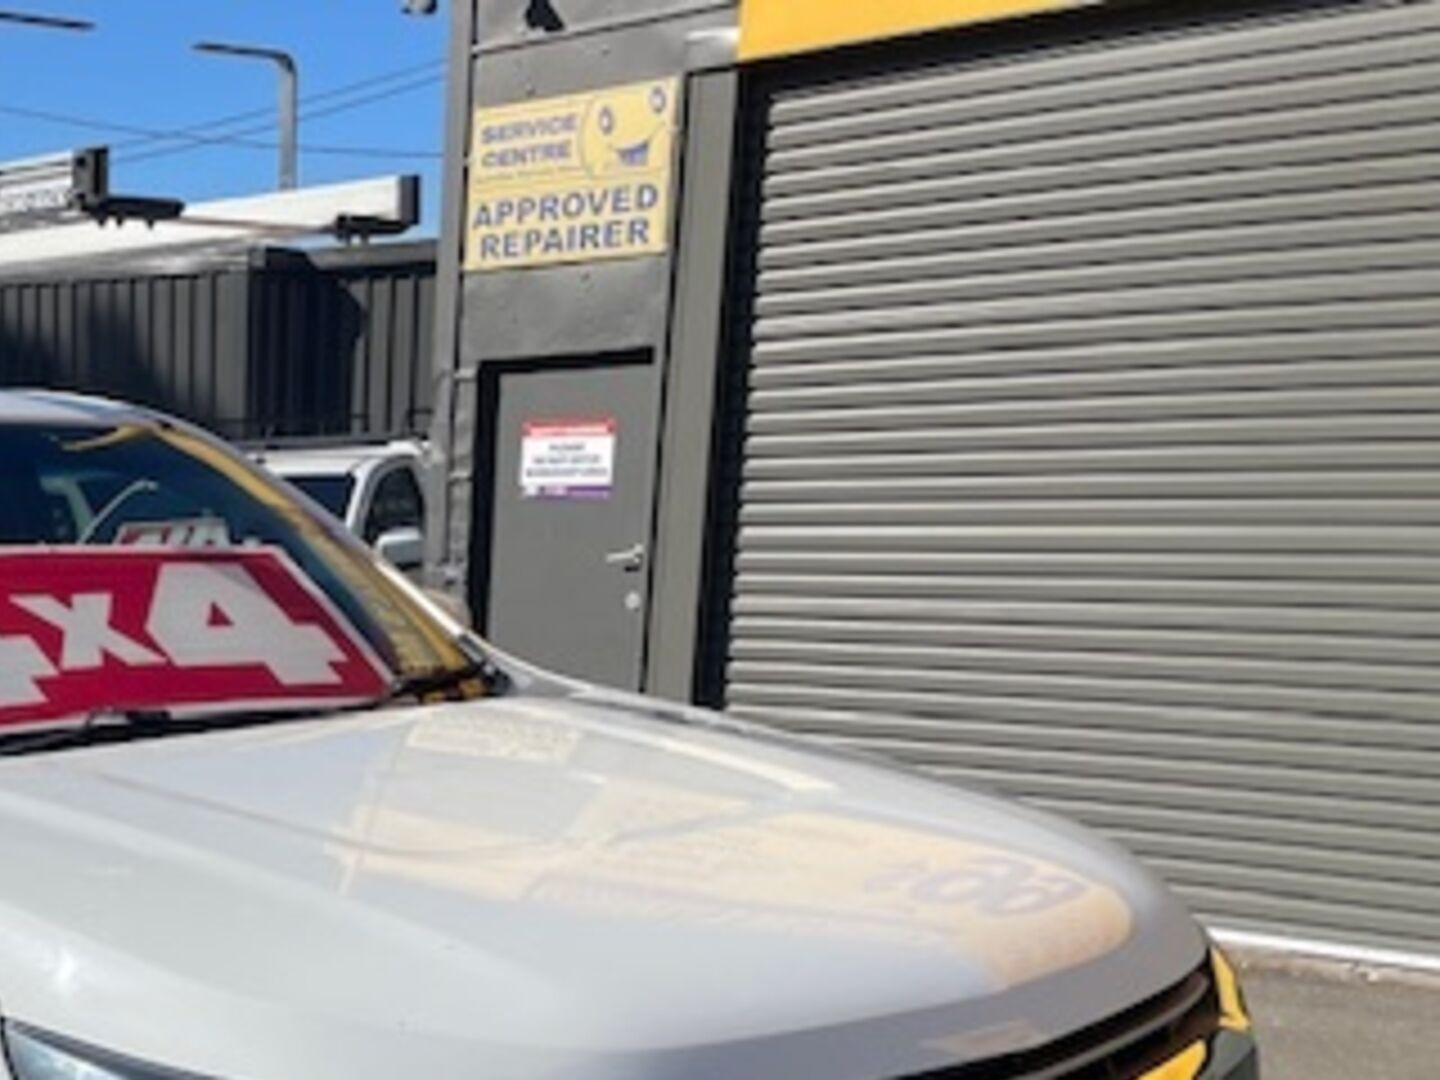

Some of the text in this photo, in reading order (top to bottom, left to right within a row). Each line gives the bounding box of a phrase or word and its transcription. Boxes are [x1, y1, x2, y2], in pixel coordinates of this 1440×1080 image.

[481, 114, 577, 143] SERVICE
[481, 139, 572, 167] CENTRE
[474, 184, 658, 228] APPROVED
[481, 219, 650, 259] REPAIRER
